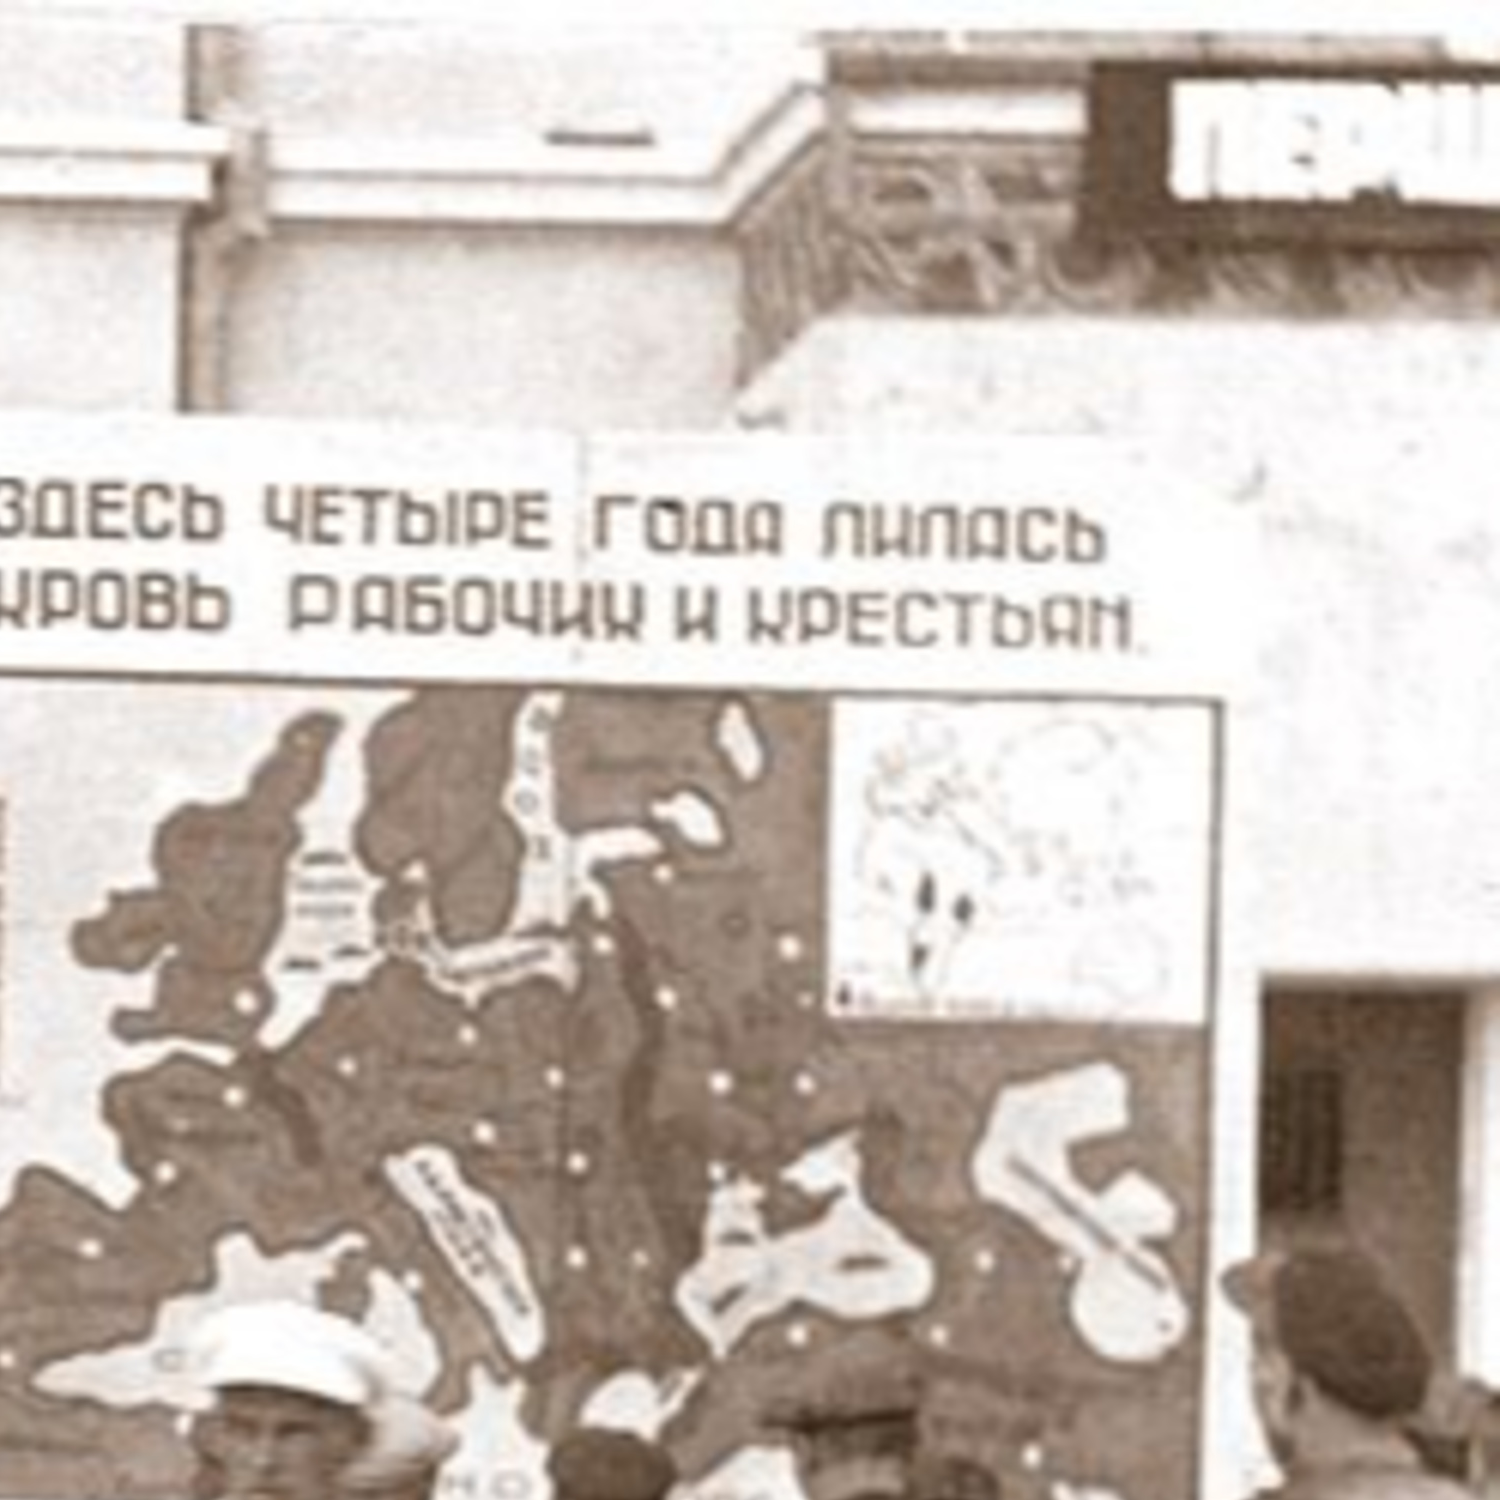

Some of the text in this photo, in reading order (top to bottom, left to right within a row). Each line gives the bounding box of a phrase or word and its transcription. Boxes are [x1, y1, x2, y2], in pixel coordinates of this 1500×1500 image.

[263, 485, 552, 548] ЧЕТЫРЕ
[594, 494, 784, 558] ГОДА
[822, 500, 1108, 564] ЛИЛАСЬ
[674, 584, 718, 640] И
